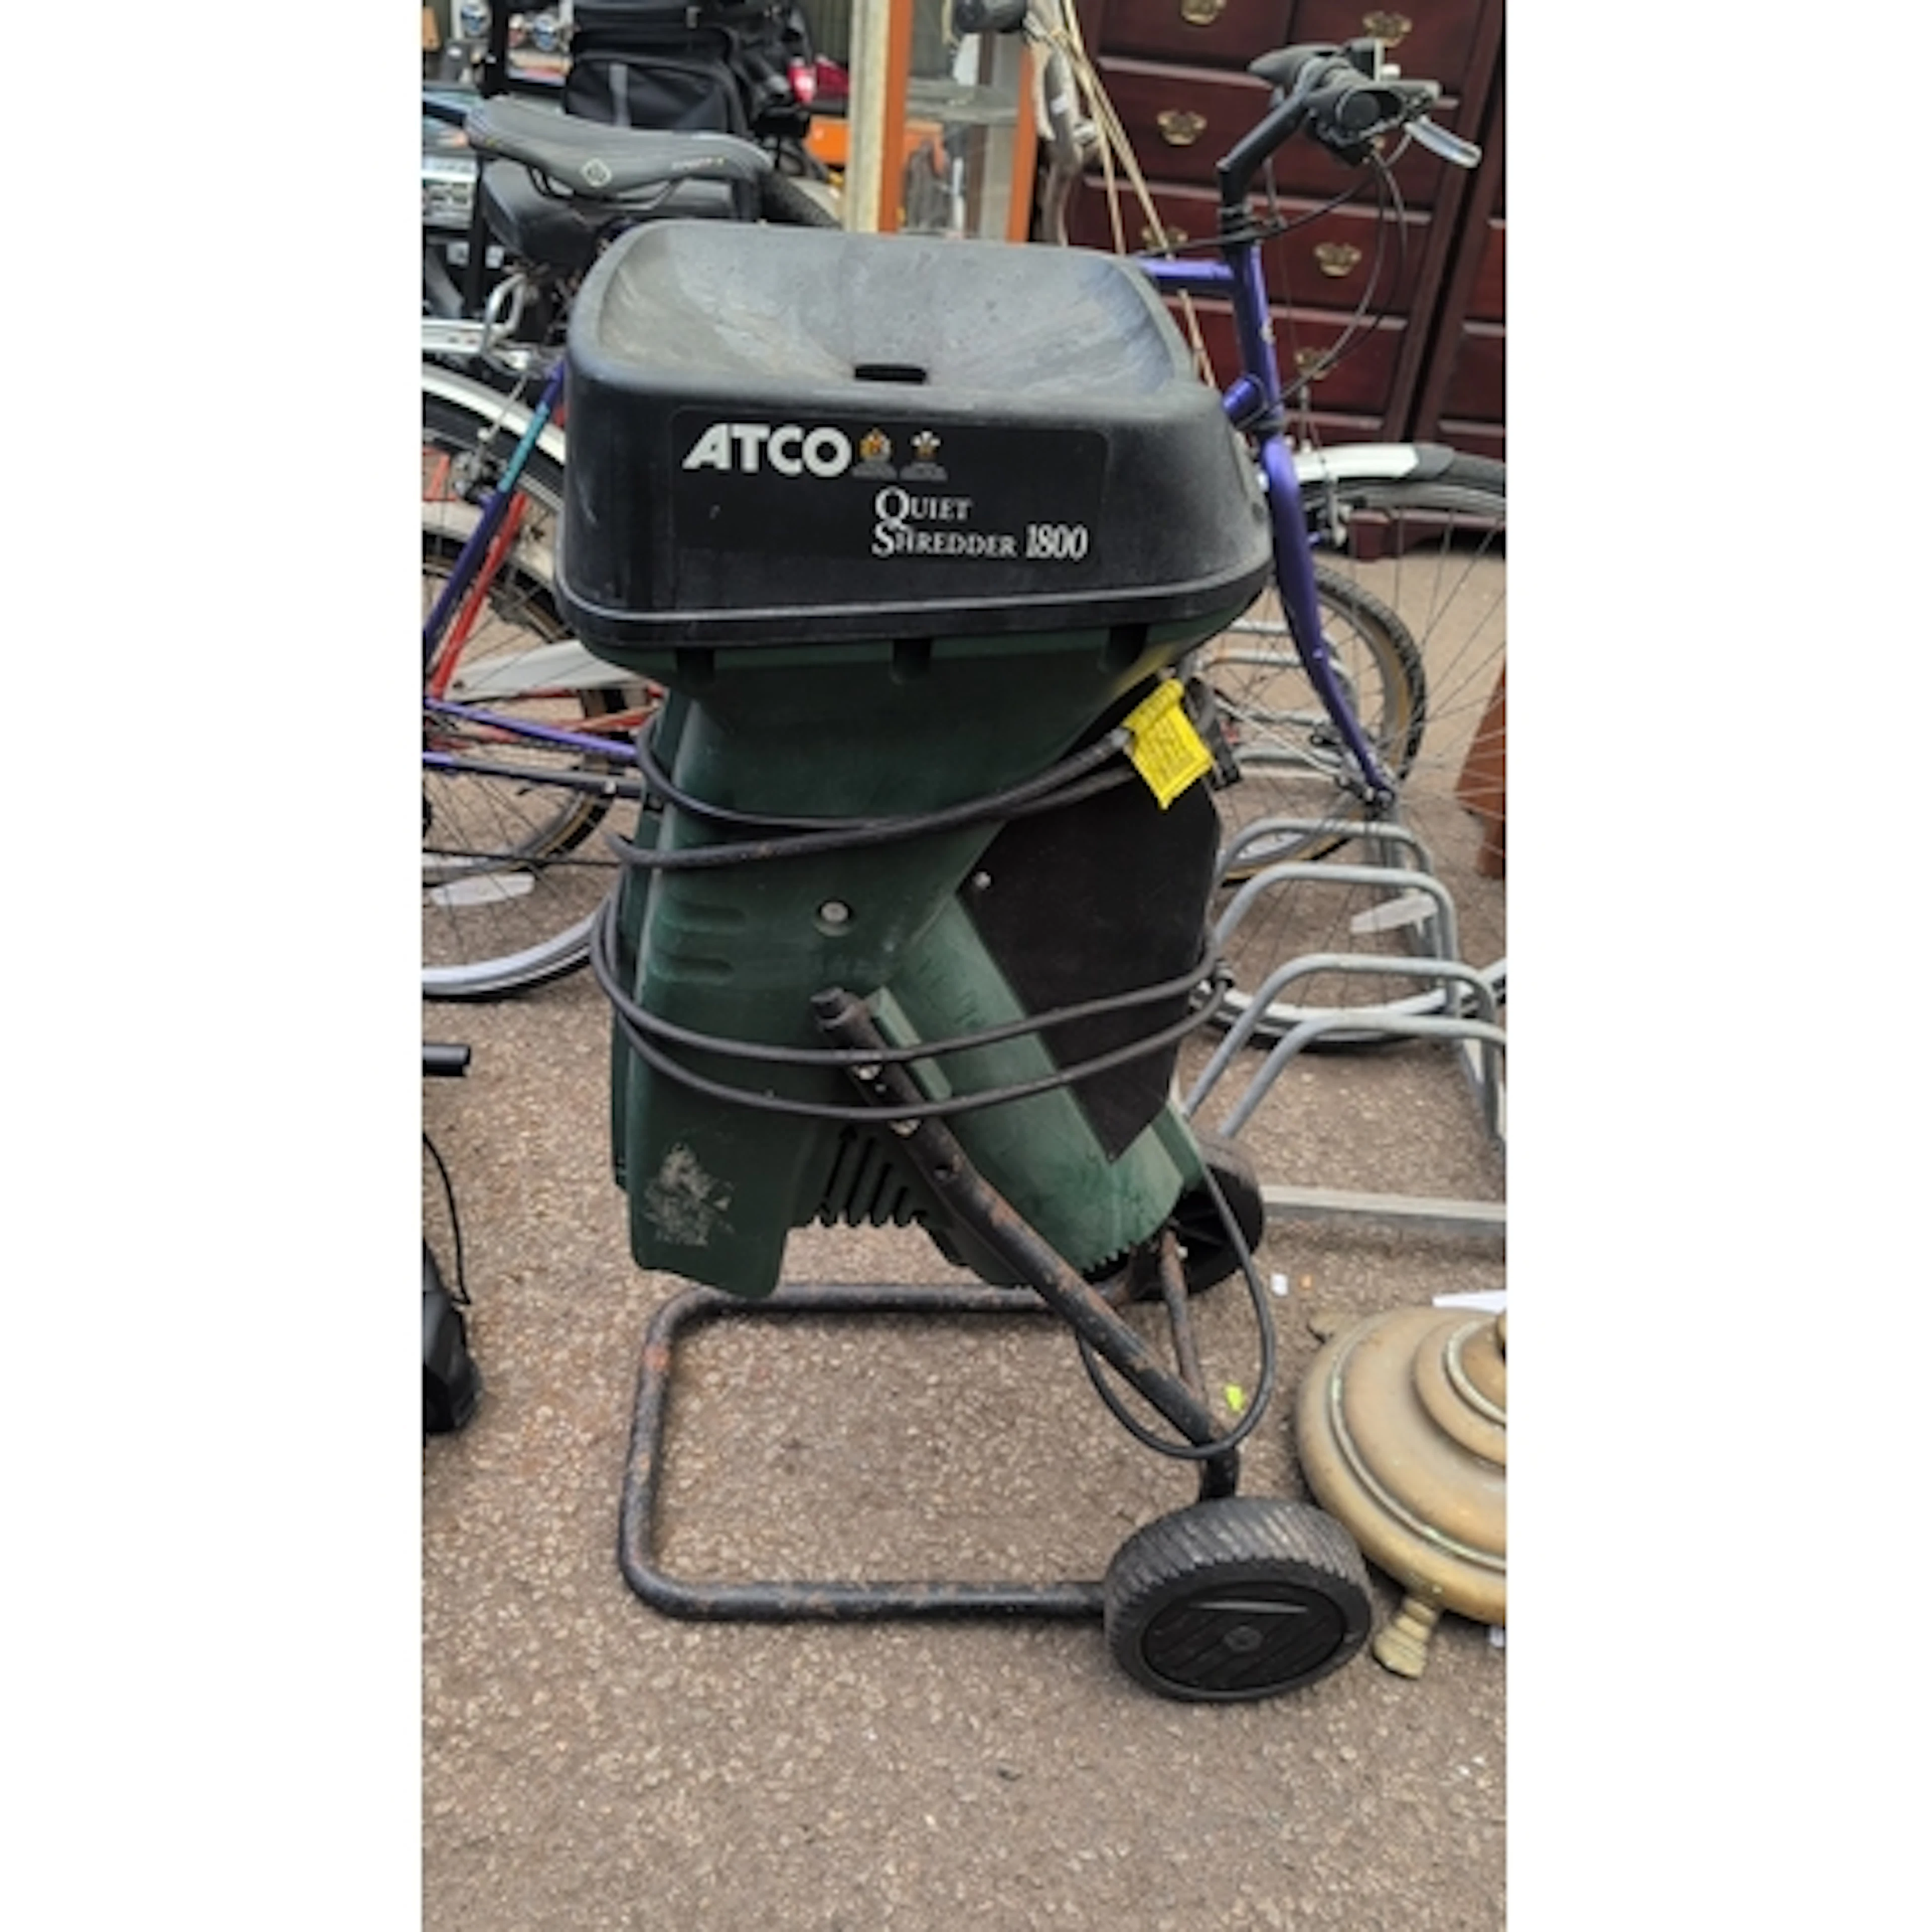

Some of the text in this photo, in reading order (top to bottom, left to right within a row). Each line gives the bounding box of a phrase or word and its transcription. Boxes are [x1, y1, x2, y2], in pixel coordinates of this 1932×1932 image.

[682, 423, 852, 477] ATCO
[875, 488, 973, 527] QUIET
[871, 521, 1089, 558] SHREDDER 1800
